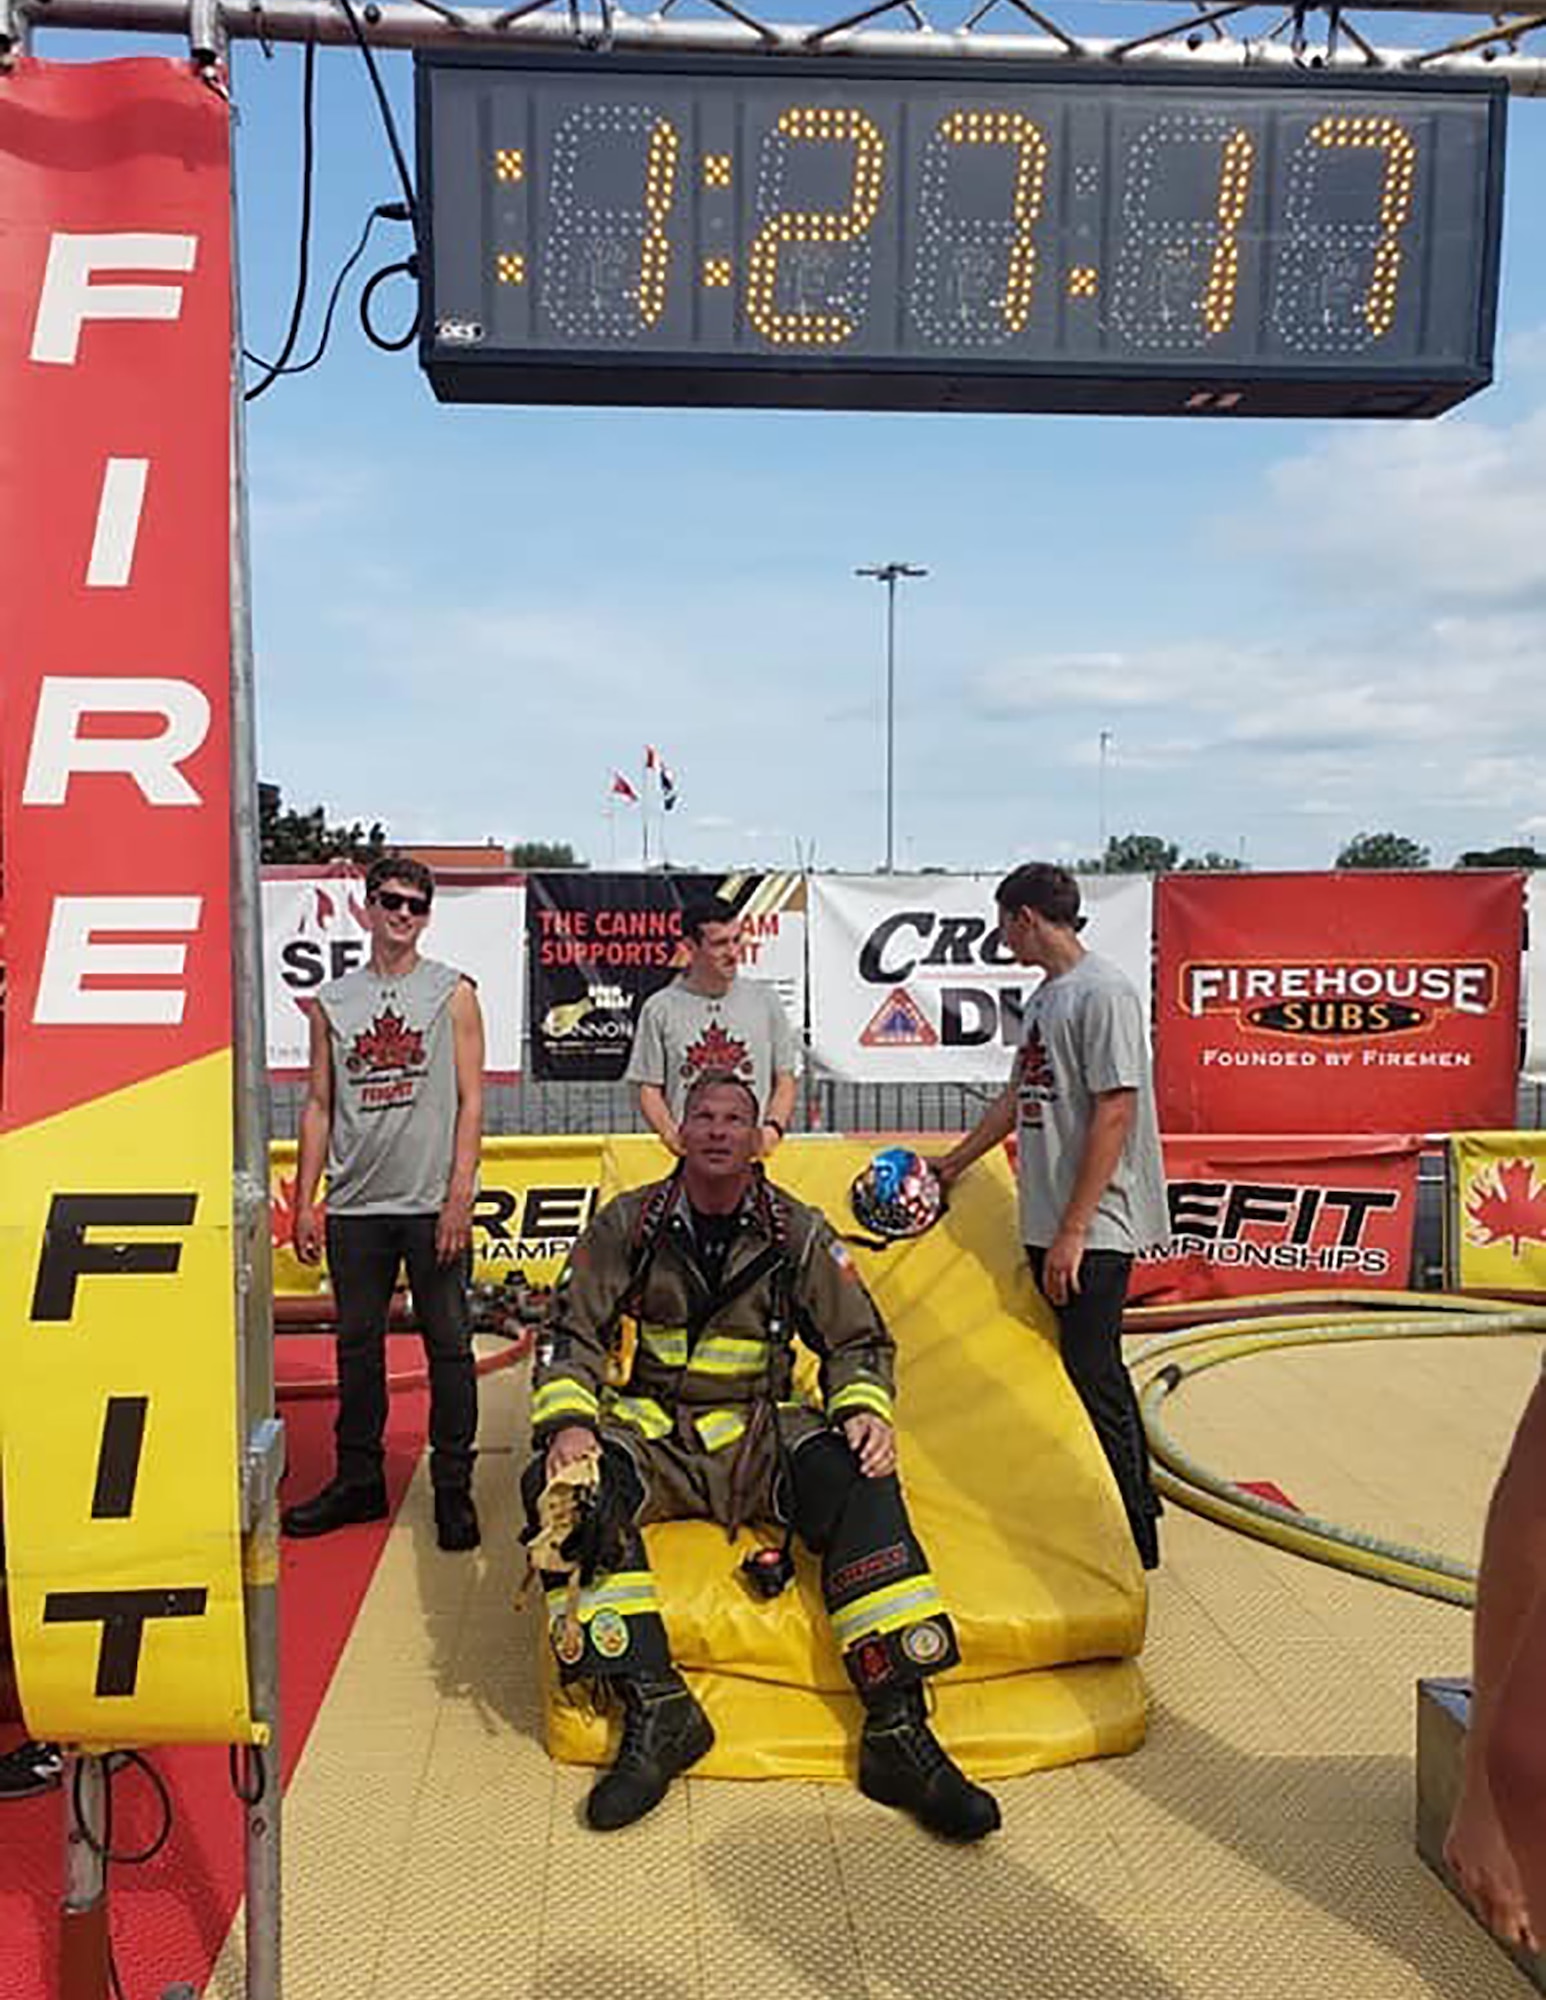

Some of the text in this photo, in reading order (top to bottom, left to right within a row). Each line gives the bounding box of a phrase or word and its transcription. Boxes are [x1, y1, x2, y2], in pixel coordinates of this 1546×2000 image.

[537, 911, 587, 936] THE
[740, 912, 779, 935] AM
[541, 941, 668, 966] SUPPORTS
[1189, 967, 1487, 1018] FIREHOUSE
[1282, 1002, 1391, 1031] SUBS
[1167, 1183, 1397, 1248] EFIT
